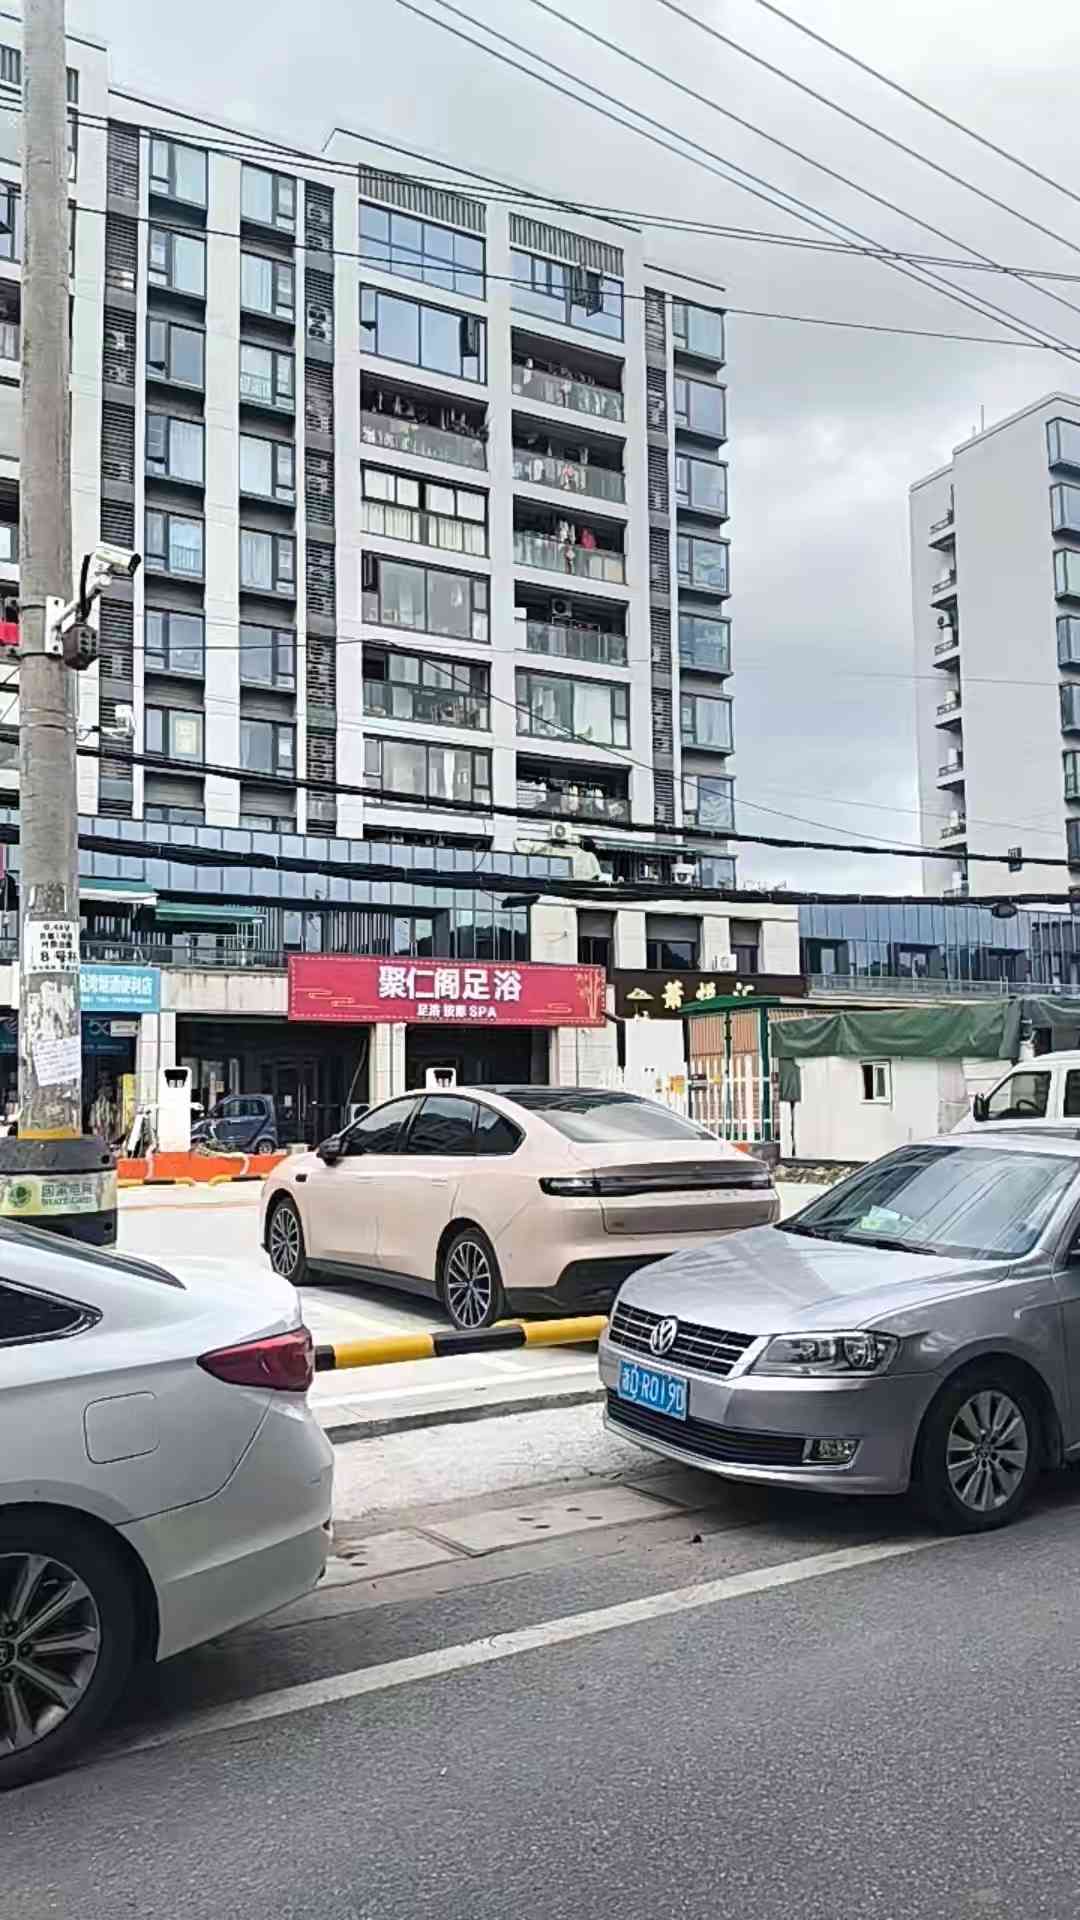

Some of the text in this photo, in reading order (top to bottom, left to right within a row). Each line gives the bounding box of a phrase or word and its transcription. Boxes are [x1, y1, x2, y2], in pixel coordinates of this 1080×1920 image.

[379, 966, 522, 1001] 聚仁阁足浴
[469, 1006, 496, 1018] SPA
